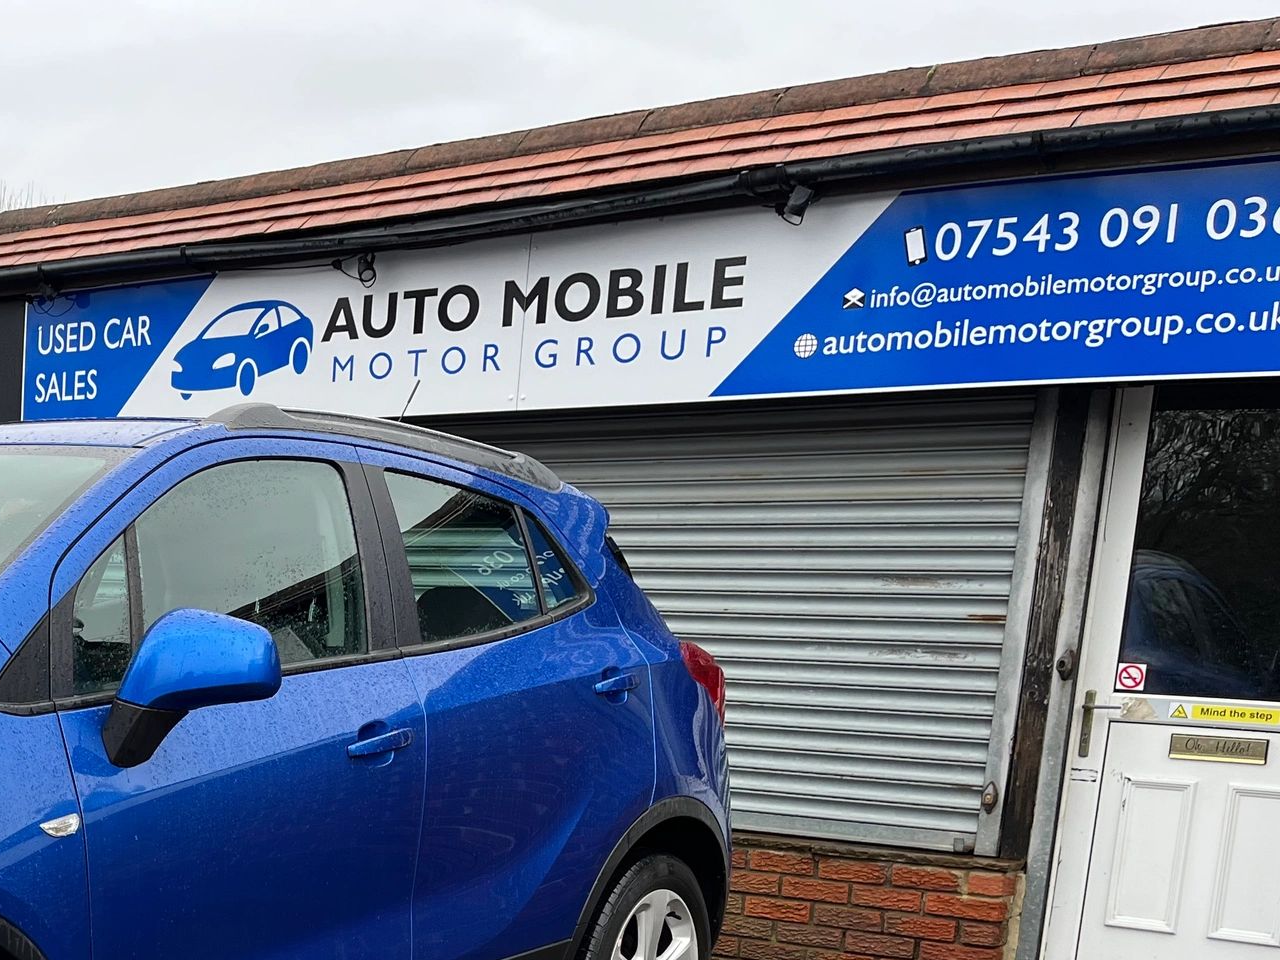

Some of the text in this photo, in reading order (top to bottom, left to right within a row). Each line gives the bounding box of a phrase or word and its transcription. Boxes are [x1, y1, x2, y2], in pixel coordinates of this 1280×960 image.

[935, 195, 1280, 262] 07543 091 03
[321, 255, 749, 343] AUTO MOBILE
[37, 315, 151, 356] USED CAR
[331, 325, 728, 383] MOTOR GROUP
[34, 368, 98, 403] SALES
[1200, 707, 1273, 721] Mind the step
